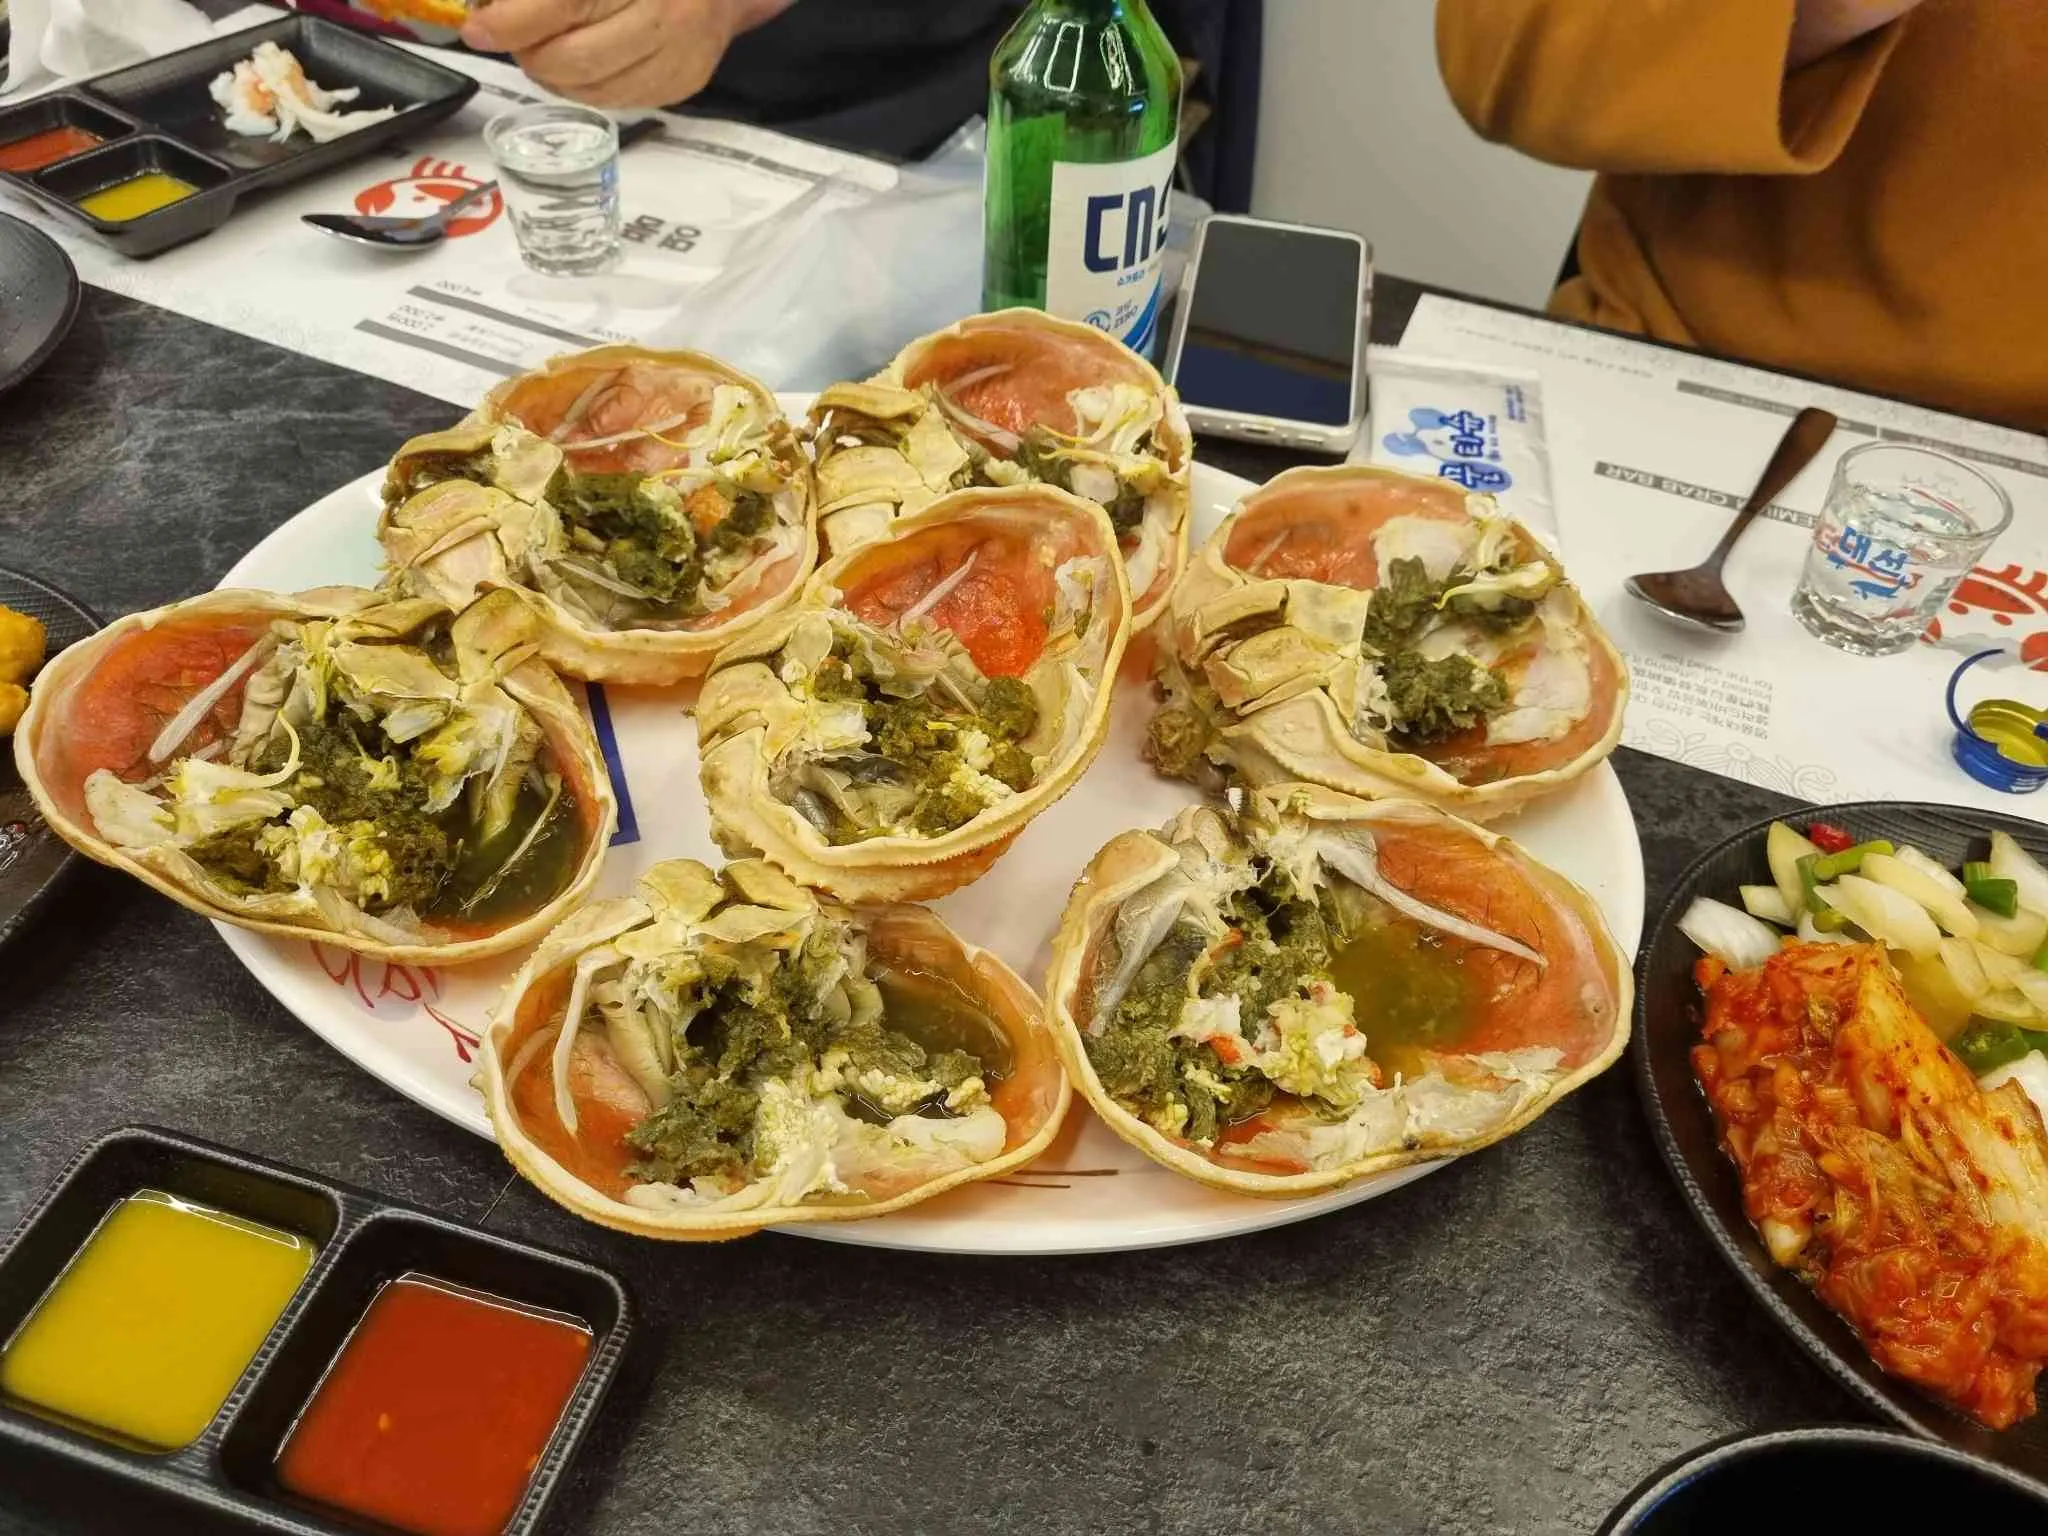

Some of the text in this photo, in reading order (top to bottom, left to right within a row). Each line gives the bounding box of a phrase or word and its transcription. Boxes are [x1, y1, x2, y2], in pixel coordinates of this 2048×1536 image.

[1605, 463, 1654, 486] BAR
[1661, 479, 1728, 505] CRAB
[1839, 526, 1908, 579] 대선
